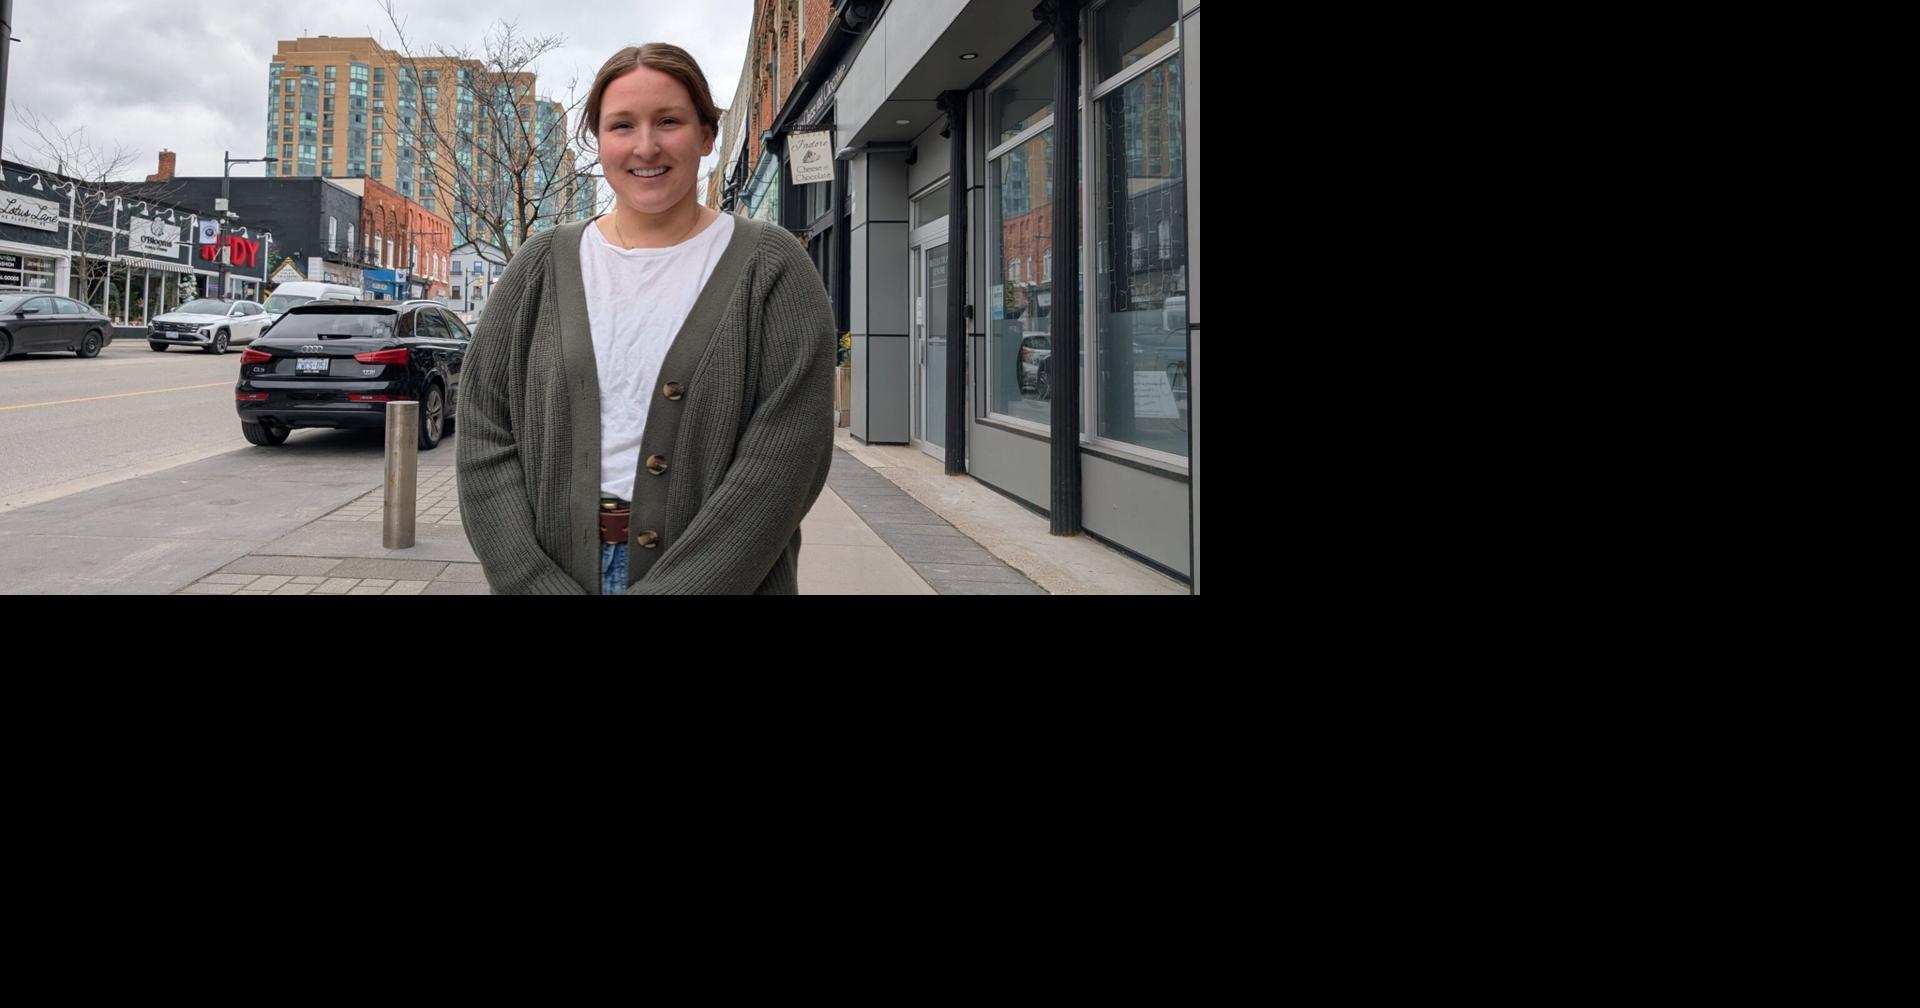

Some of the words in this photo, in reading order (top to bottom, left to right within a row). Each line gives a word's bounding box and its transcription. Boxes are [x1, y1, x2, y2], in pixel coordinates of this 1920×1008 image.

[796, 173, 832, 182] Chocolate
[0, 198, 30, 217] Lotus
[31, 205, 58, 223] Lane
